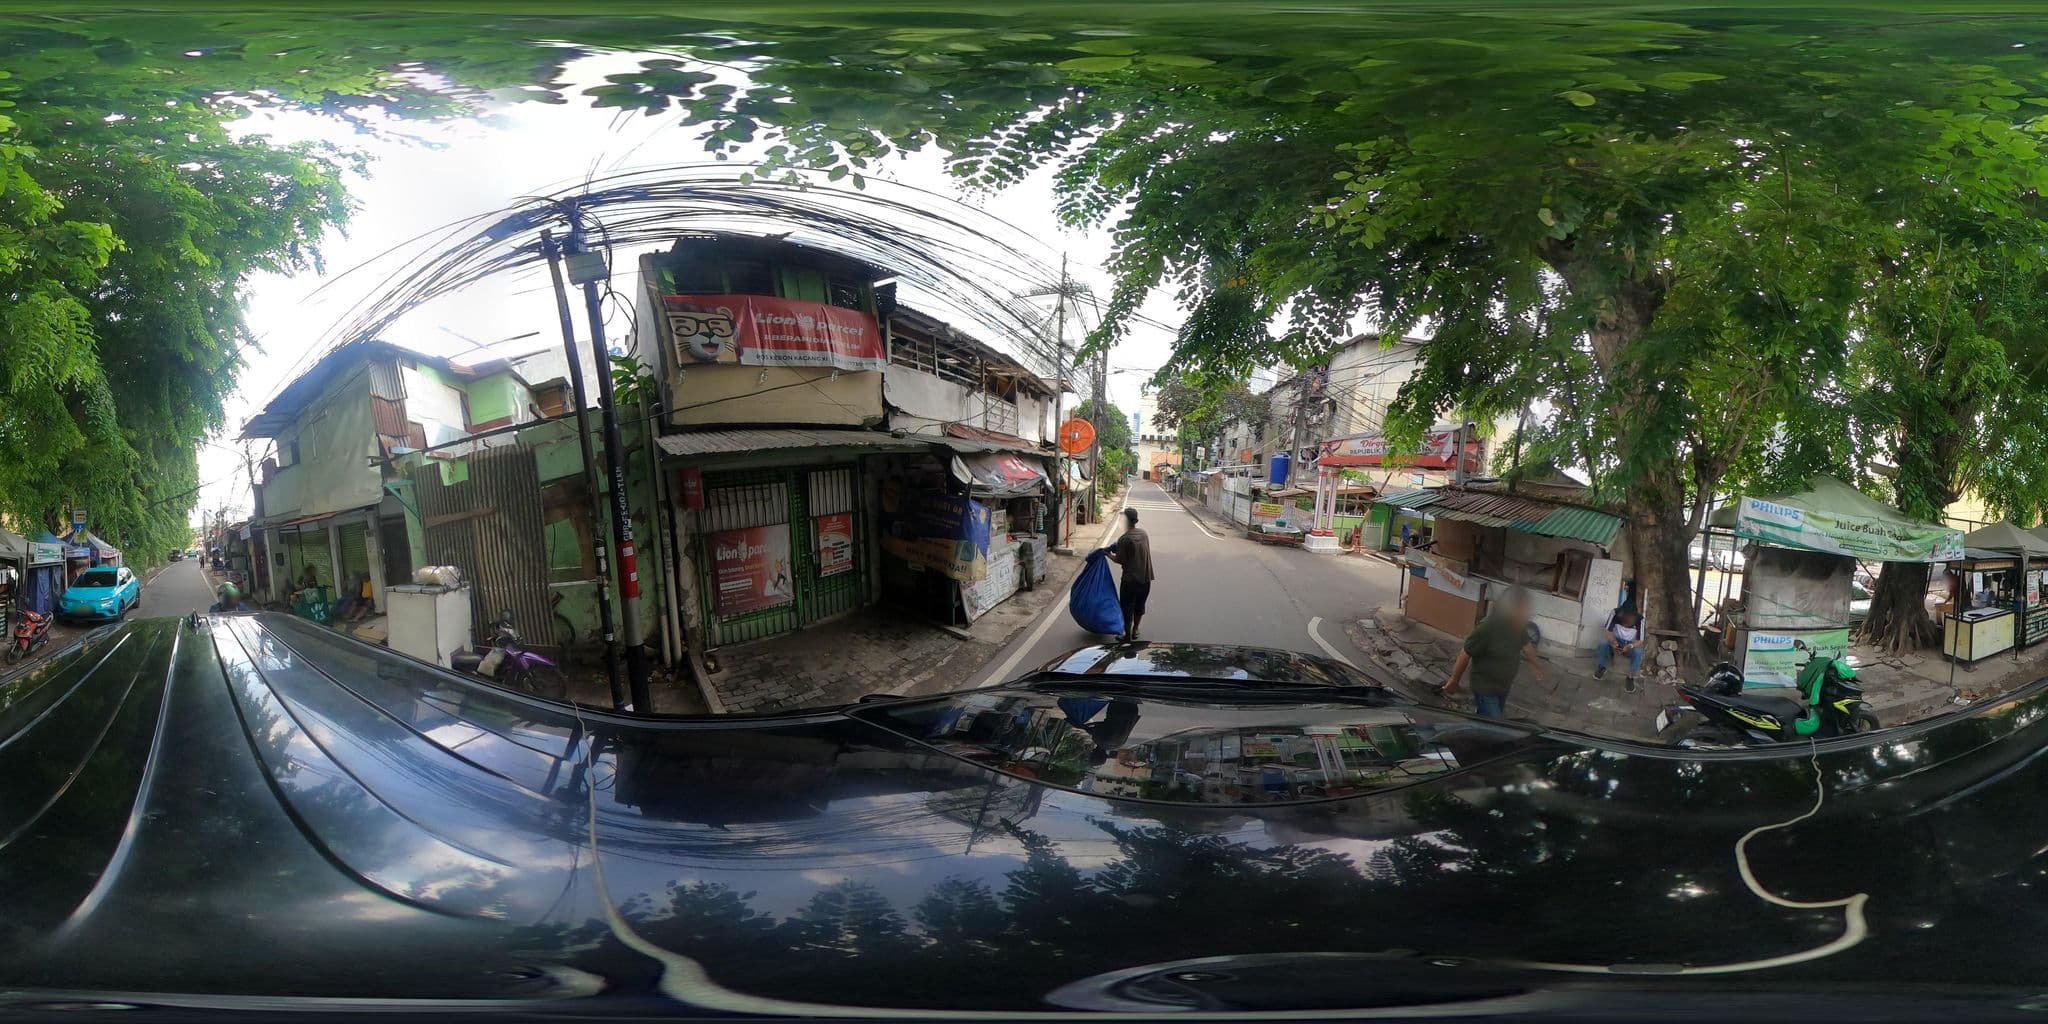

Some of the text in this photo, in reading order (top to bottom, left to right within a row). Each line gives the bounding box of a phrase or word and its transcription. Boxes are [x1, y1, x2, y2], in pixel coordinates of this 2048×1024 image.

[755, 313, 864, 336] Lion parcel
[1751, 499, 1800, 520] PHILIPS
[1834, 519, 1861, 533] Juice
[1862, 523, 1886, 538] Buah
[716, 545, 738, 561] Lion
[1753, 635, 1792, 644] PHILIPS
